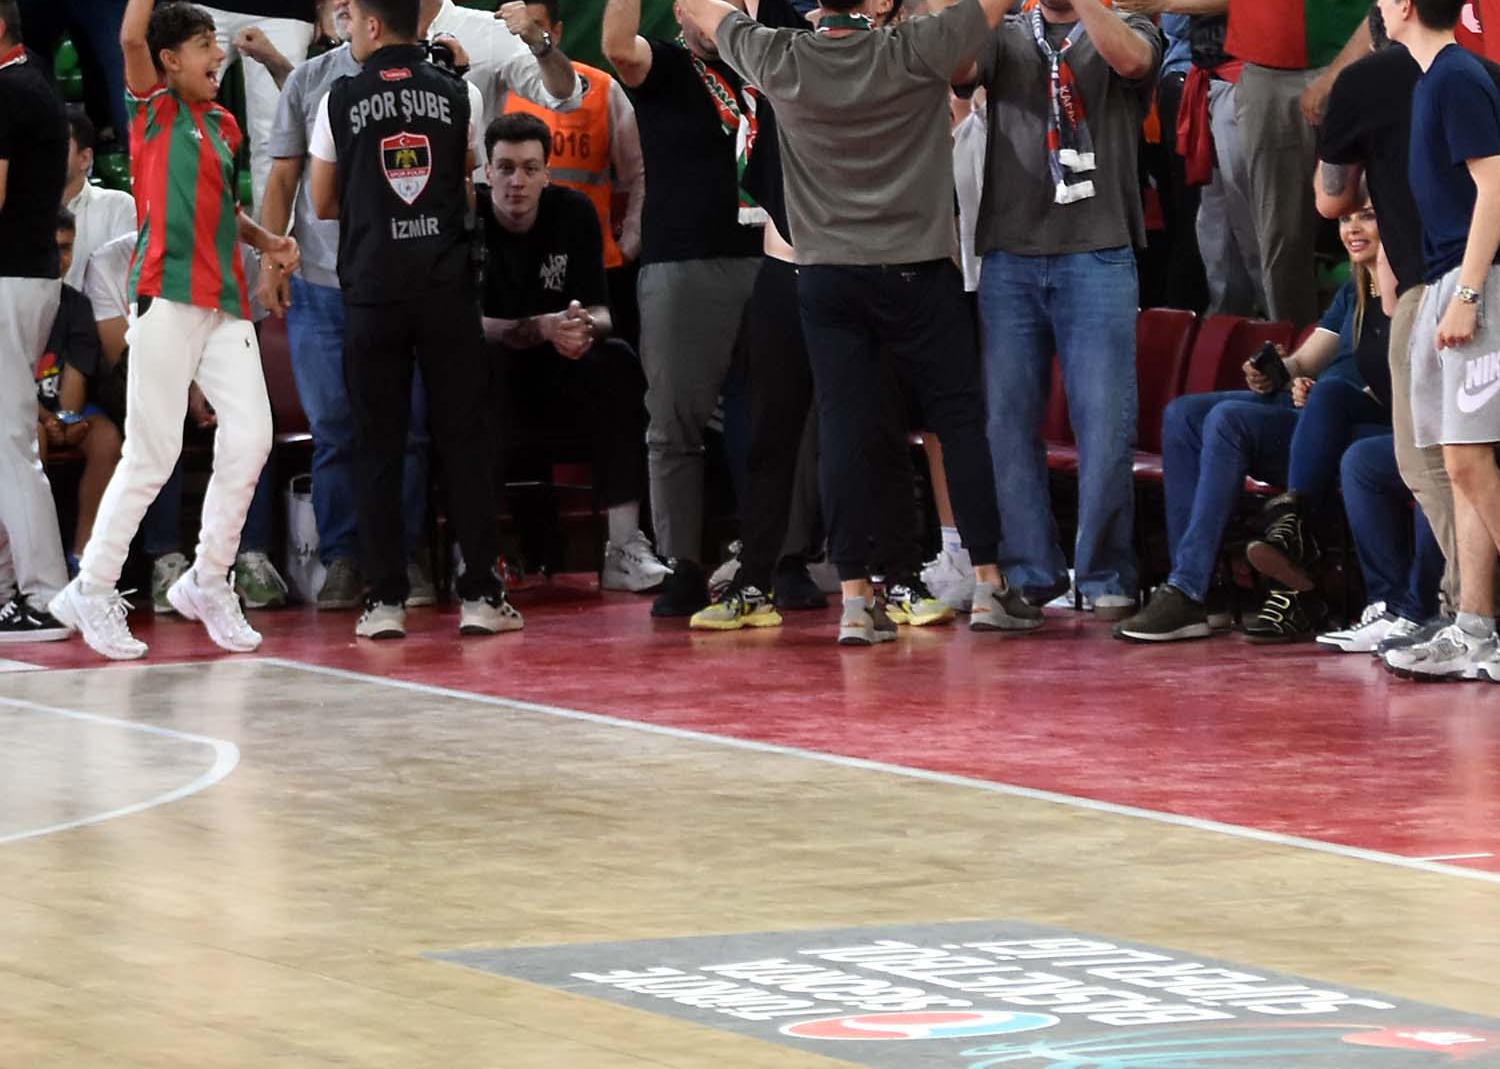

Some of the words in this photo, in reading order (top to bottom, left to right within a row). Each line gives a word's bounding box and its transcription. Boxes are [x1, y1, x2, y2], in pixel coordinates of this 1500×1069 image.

[350, 90, 397, 134] SPOR
[401, 89, 452, 123] ŞUBE
[391, 214, 440, 239] İZMİR
[942, 937, 1174, 968] LİGİ
[570, 966, 843, 1021] TÜRKİYE
[699, 958, 974, 1012] SİGORTA
[798, 939, 1236, 1026] BASKETBOL
[1083, 963, 1396, 1015] SÜPER
